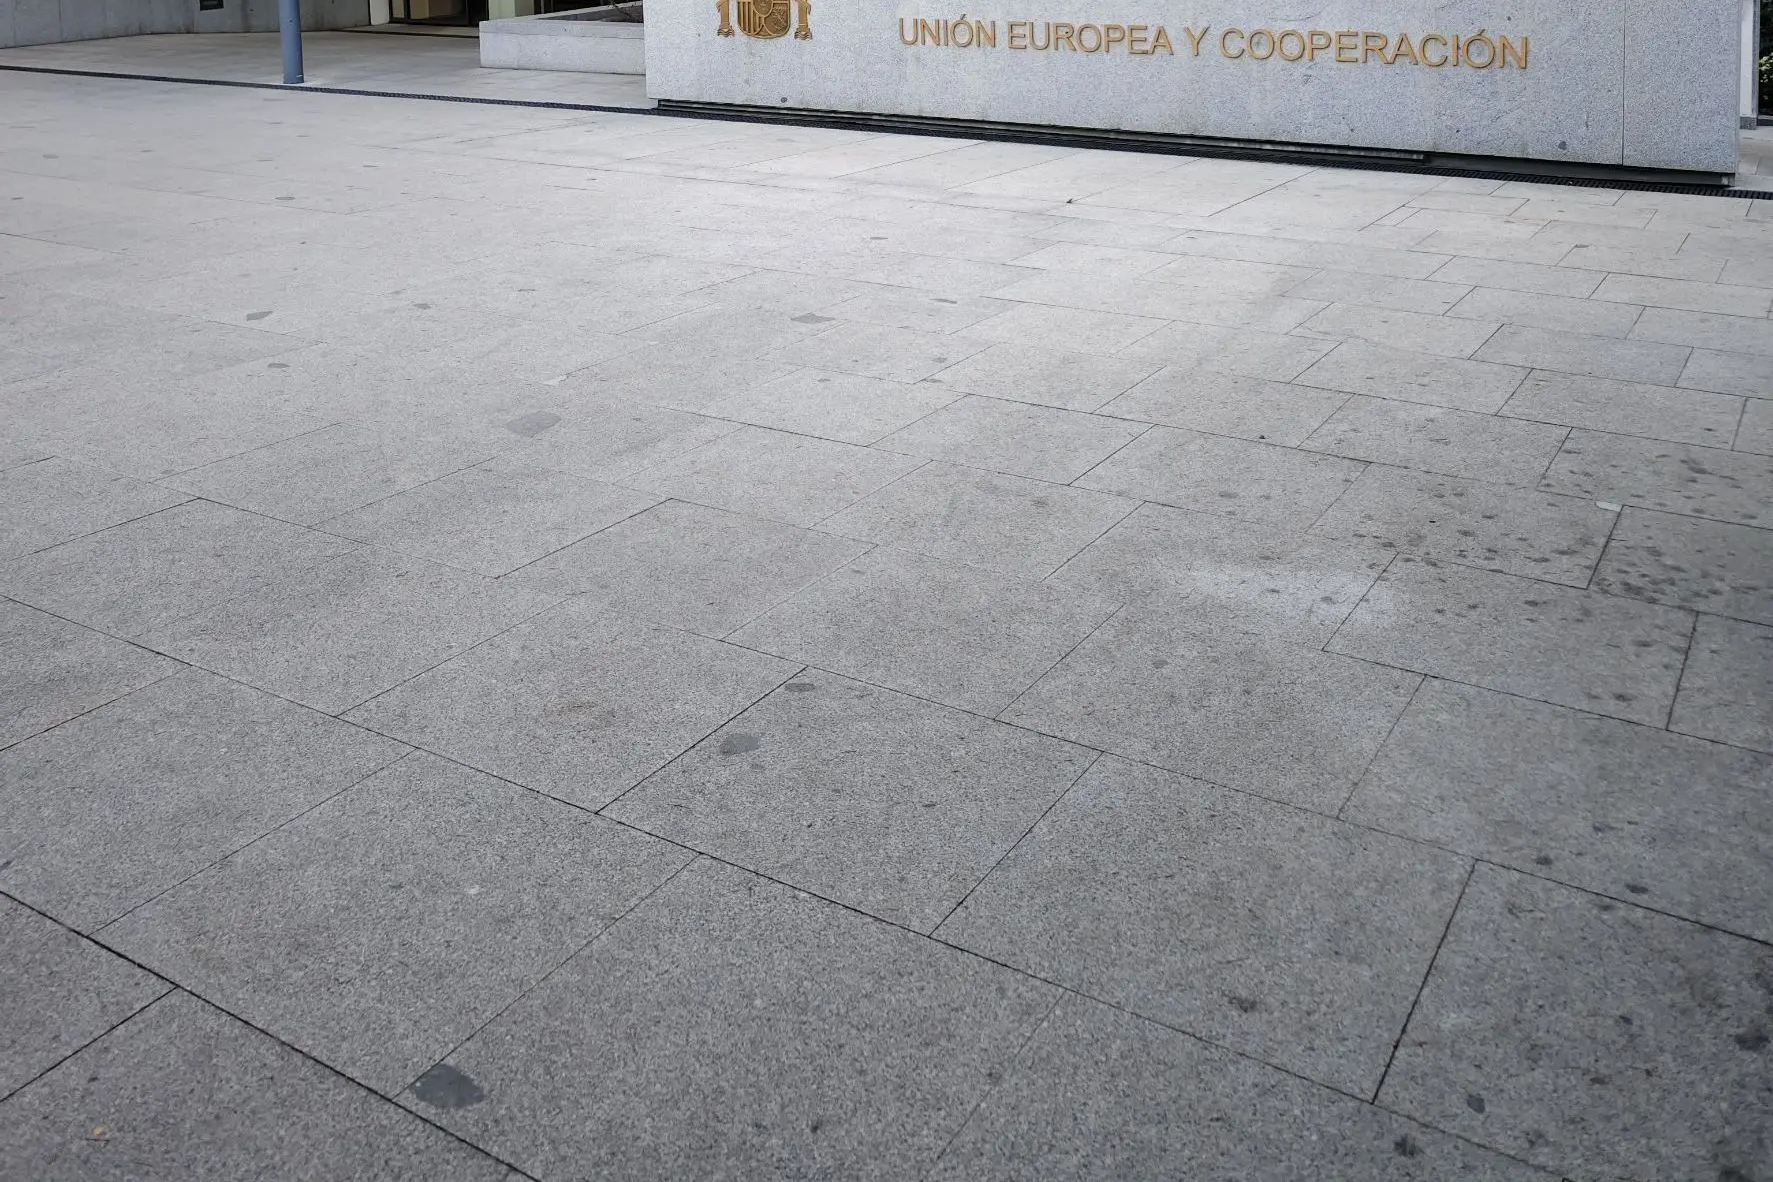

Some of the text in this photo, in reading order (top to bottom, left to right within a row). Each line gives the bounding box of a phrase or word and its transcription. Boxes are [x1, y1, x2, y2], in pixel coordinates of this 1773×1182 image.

[899, 14, 1529, 69] UNIÓN EUROPEA Y COOPERACIÓN
